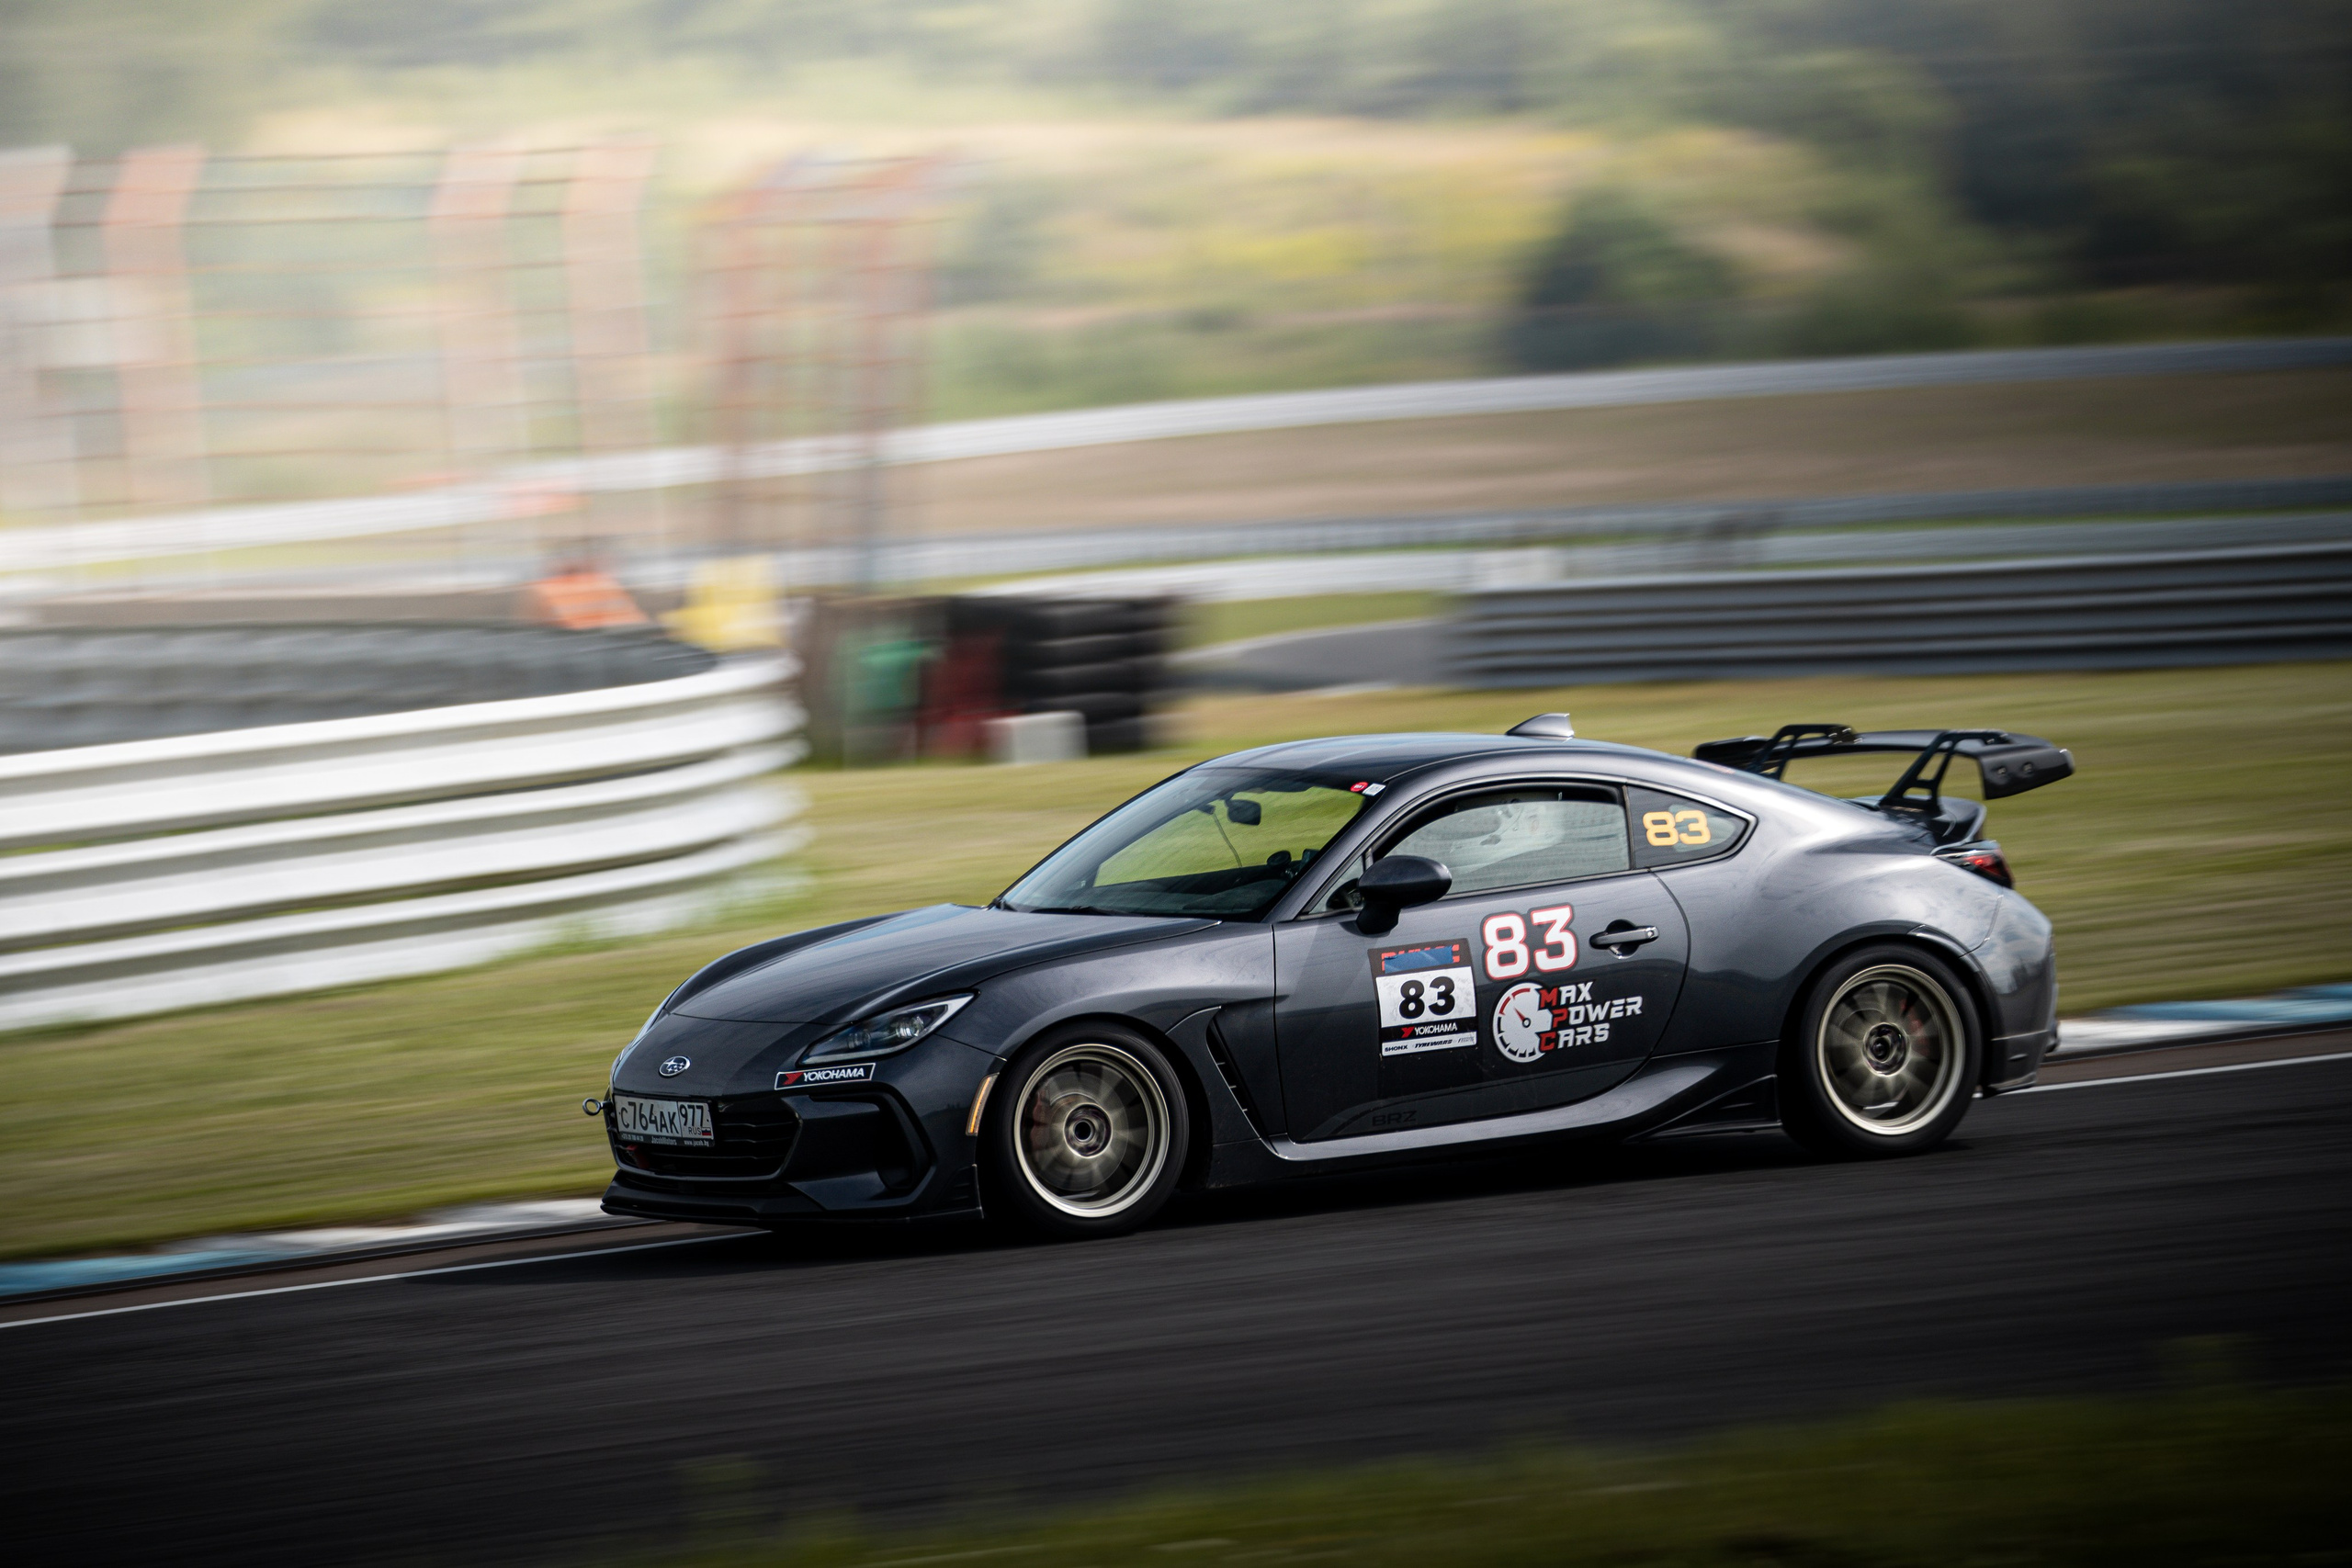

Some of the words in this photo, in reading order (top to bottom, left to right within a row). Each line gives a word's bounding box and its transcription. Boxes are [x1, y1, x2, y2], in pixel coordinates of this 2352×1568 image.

[1643, 809, 1712, 847] 83
[1481, 904, 1578, 981] 83
[1398, 976, 1456, 1020] 83
[1538, 981, 1594, 1009] MAX
[1552, 996, 1643, 1028] POWER
[1415, 1022, 1458, 1036] YOKOHAMA
[1538, 1023, 1611, 1052] CARS
[802, 1067, 865, 1083] YOKOHAMA
[680, 1104, 704, 1127] 977
[1372, 1110, 1419, 1127] BRZ
[688, 1126, 701, 1135] RUS
